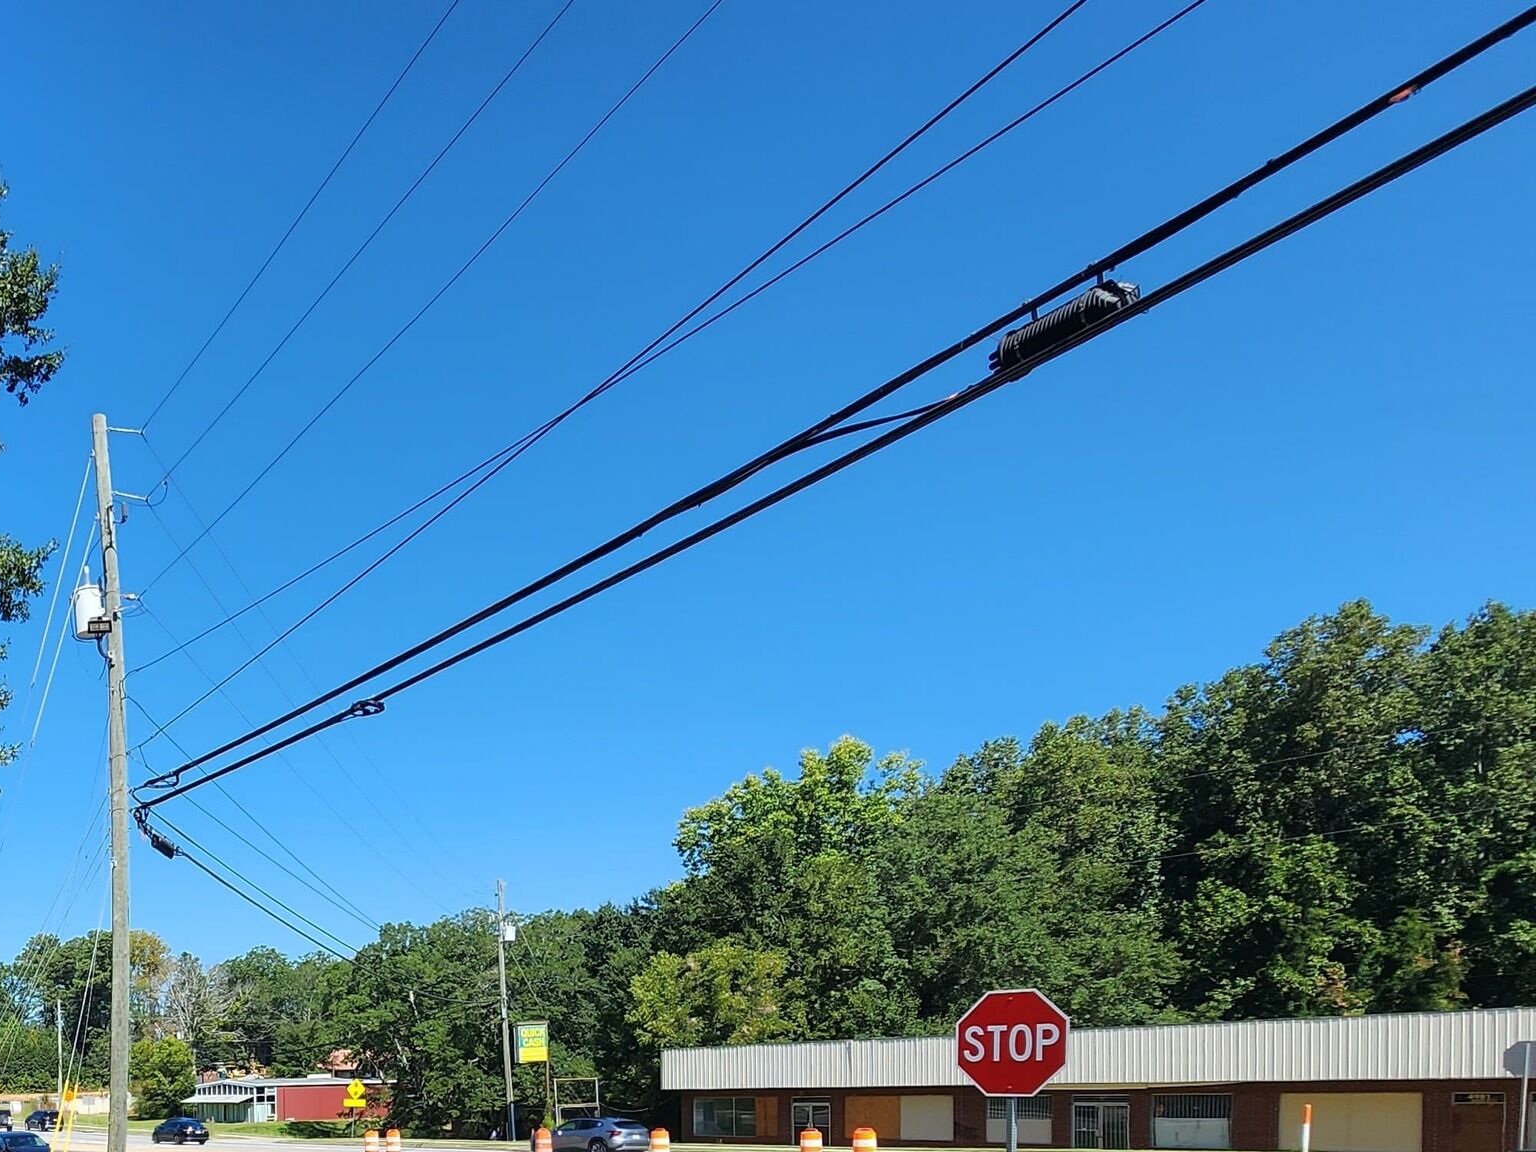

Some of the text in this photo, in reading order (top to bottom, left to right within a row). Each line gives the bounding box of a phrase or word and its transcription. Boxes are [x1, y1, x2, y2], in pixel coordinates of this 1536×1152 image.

[521, 1027, 546, 1037] QUICK
[523, 1037, 545, 1047] CASH
[963, 1023, 1060, 1062] STOP
